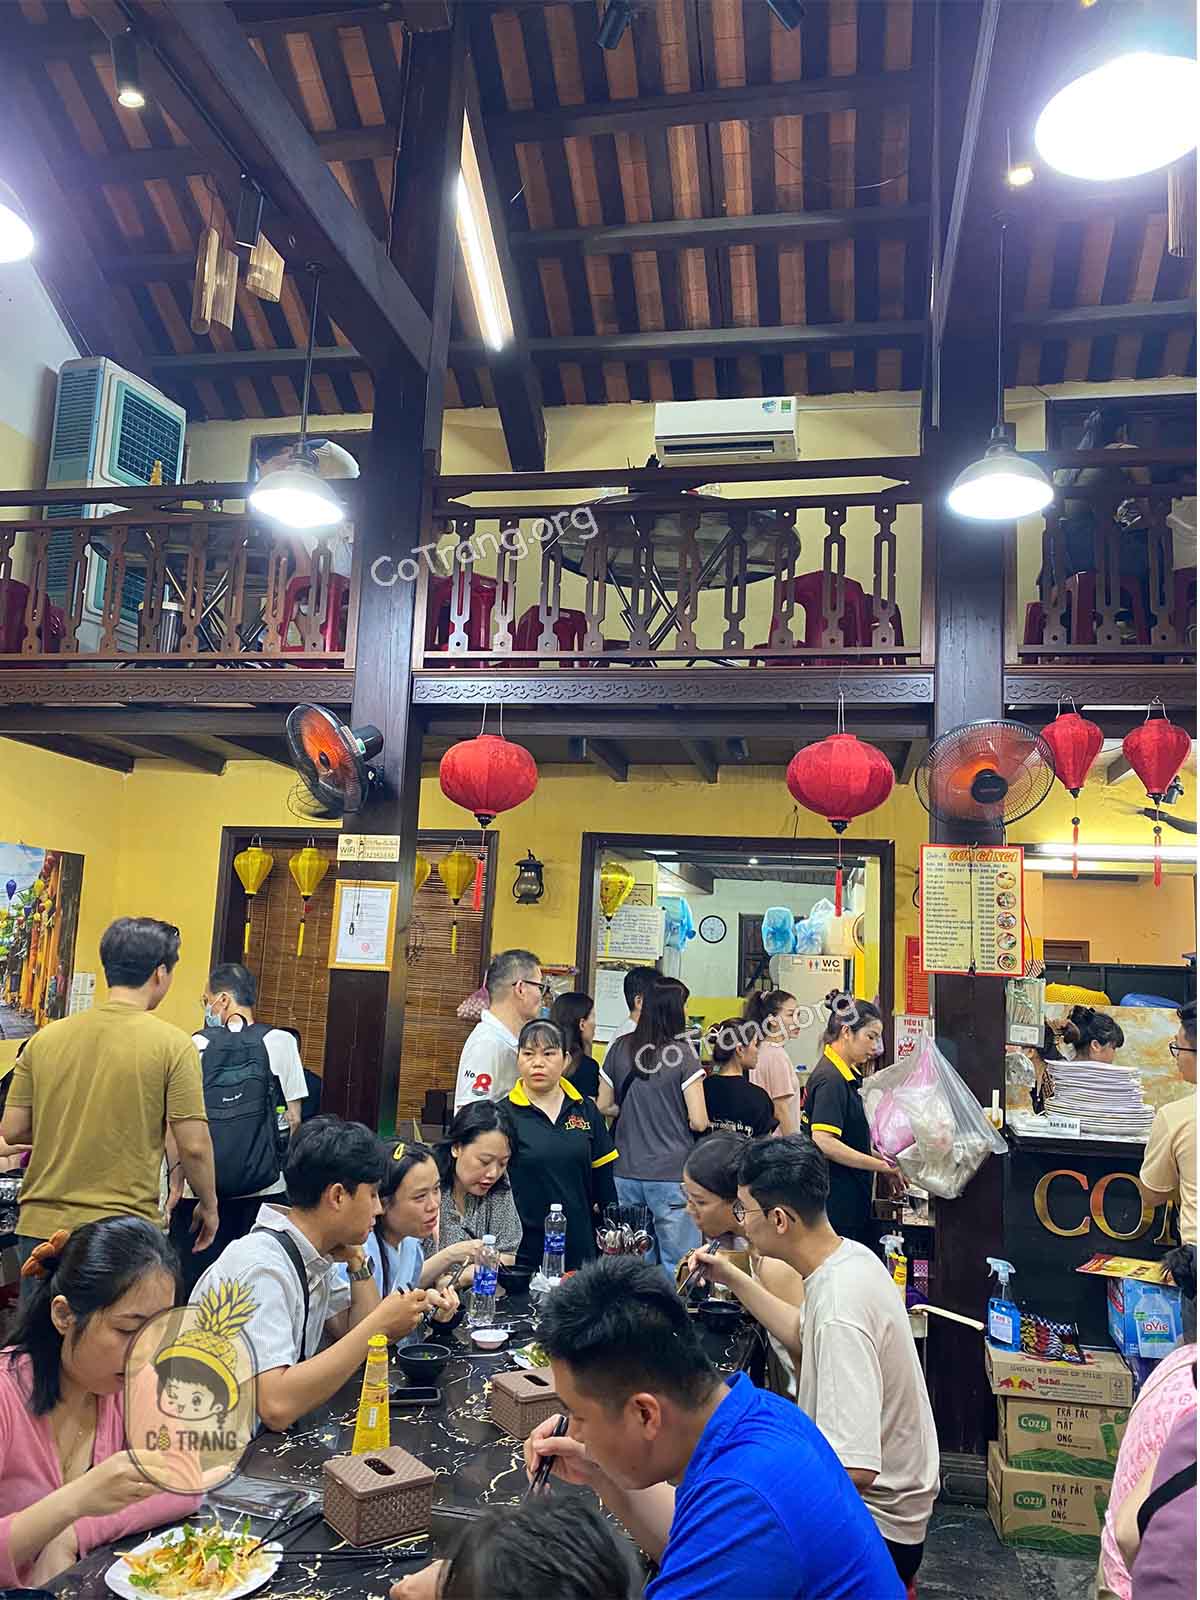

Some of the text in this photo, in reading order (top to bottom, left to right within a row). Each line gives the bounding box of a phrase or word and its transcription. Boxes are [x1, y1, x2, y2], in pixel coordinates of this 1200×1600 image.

[822, 959, 840, 968] WC
[1021, 1416, 1048, 1432] Cozy
[1016, 1494, 1043, 1508] Cozy
